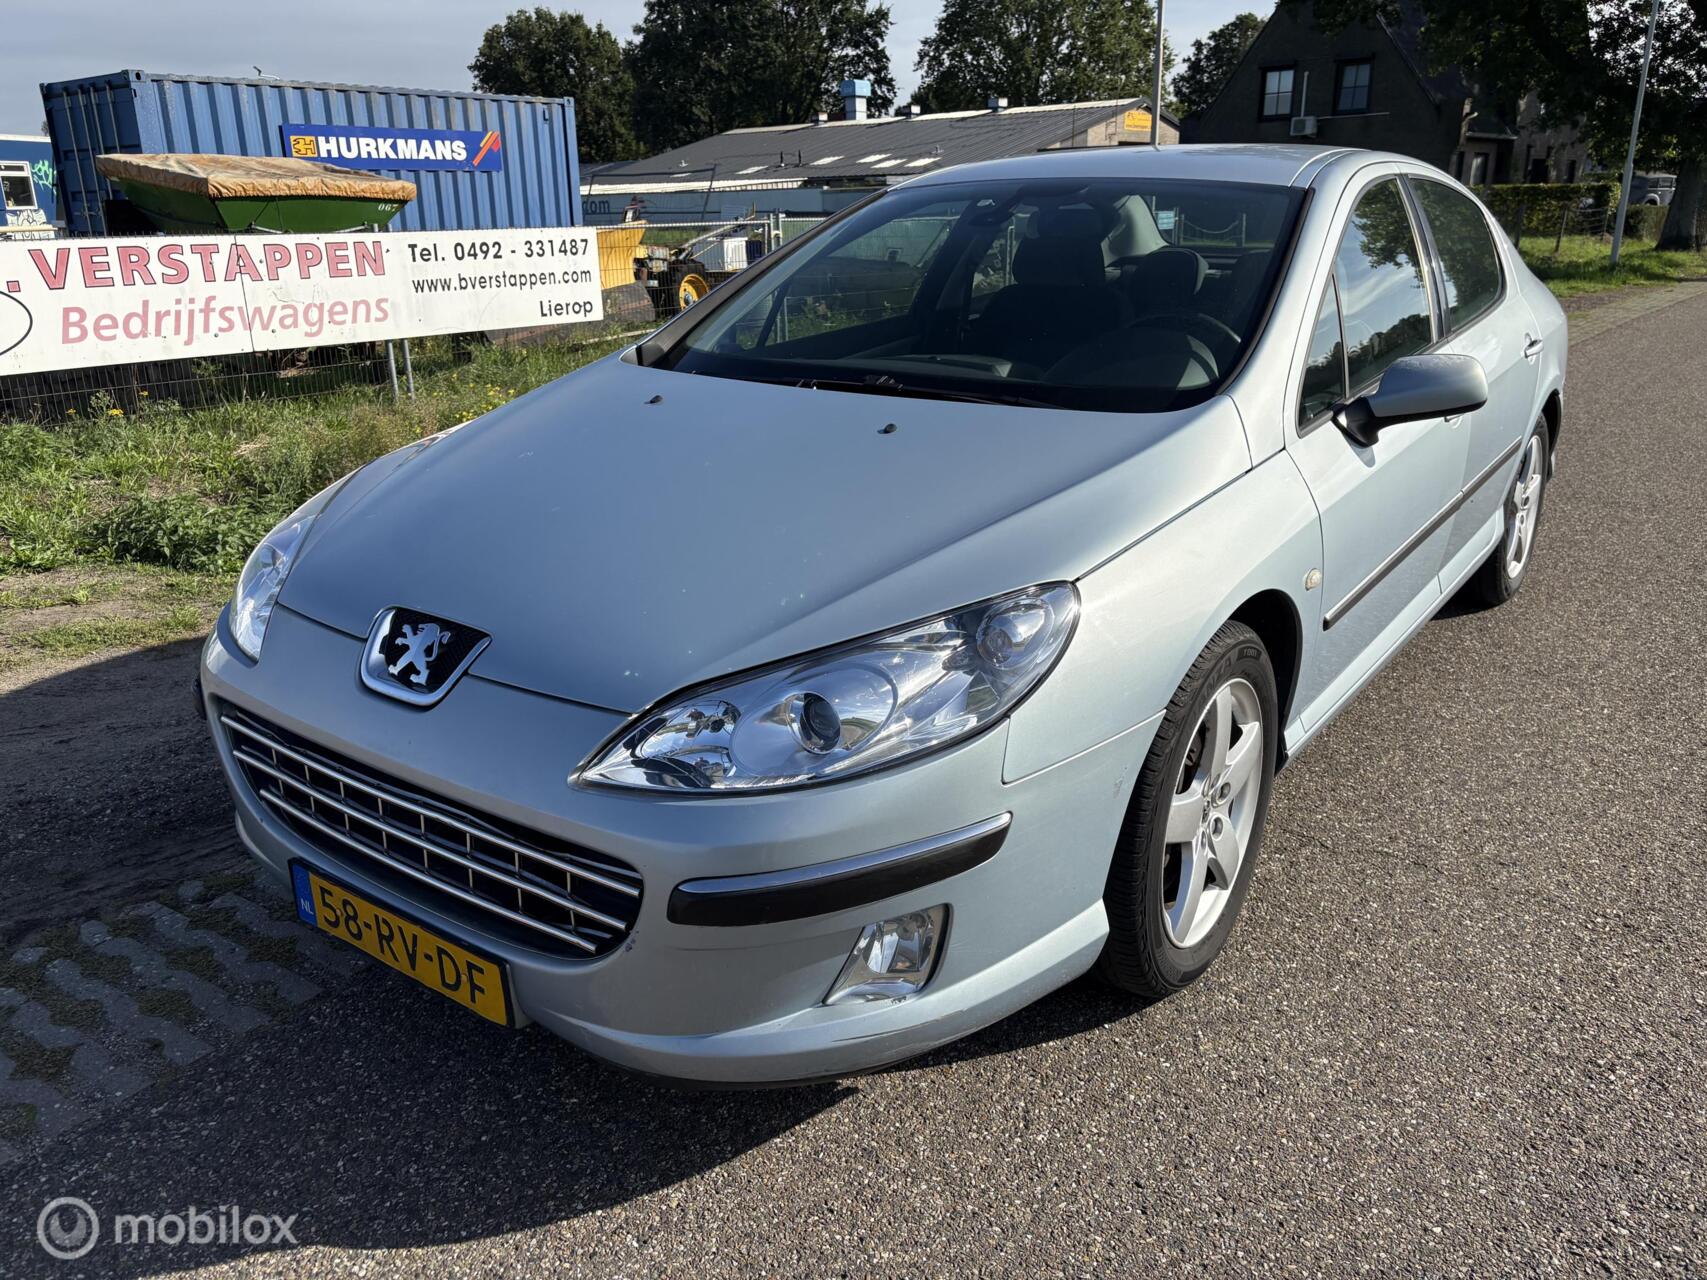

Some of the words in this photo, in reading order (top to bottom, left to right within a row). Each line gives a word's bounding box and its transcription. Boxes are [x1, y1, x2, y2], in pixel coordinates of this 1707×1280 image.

[317, 136, 467, 161] HURKMANS
[378, 203, 399, 212] 067
[408, 243, 445, 262] Tel.
[454, 241, 503, 261] 0492
[524, 238, 589, 258] 331487
[412, 270, 592, 293] www.bverstappen.com
[539, 300, 594, 317] Lierop
[62, 296, 389, 346] Bedrijfswagens
[300, 898, 314, 916] NL
[319, 885, 485, 1004] 58-RV-DF
